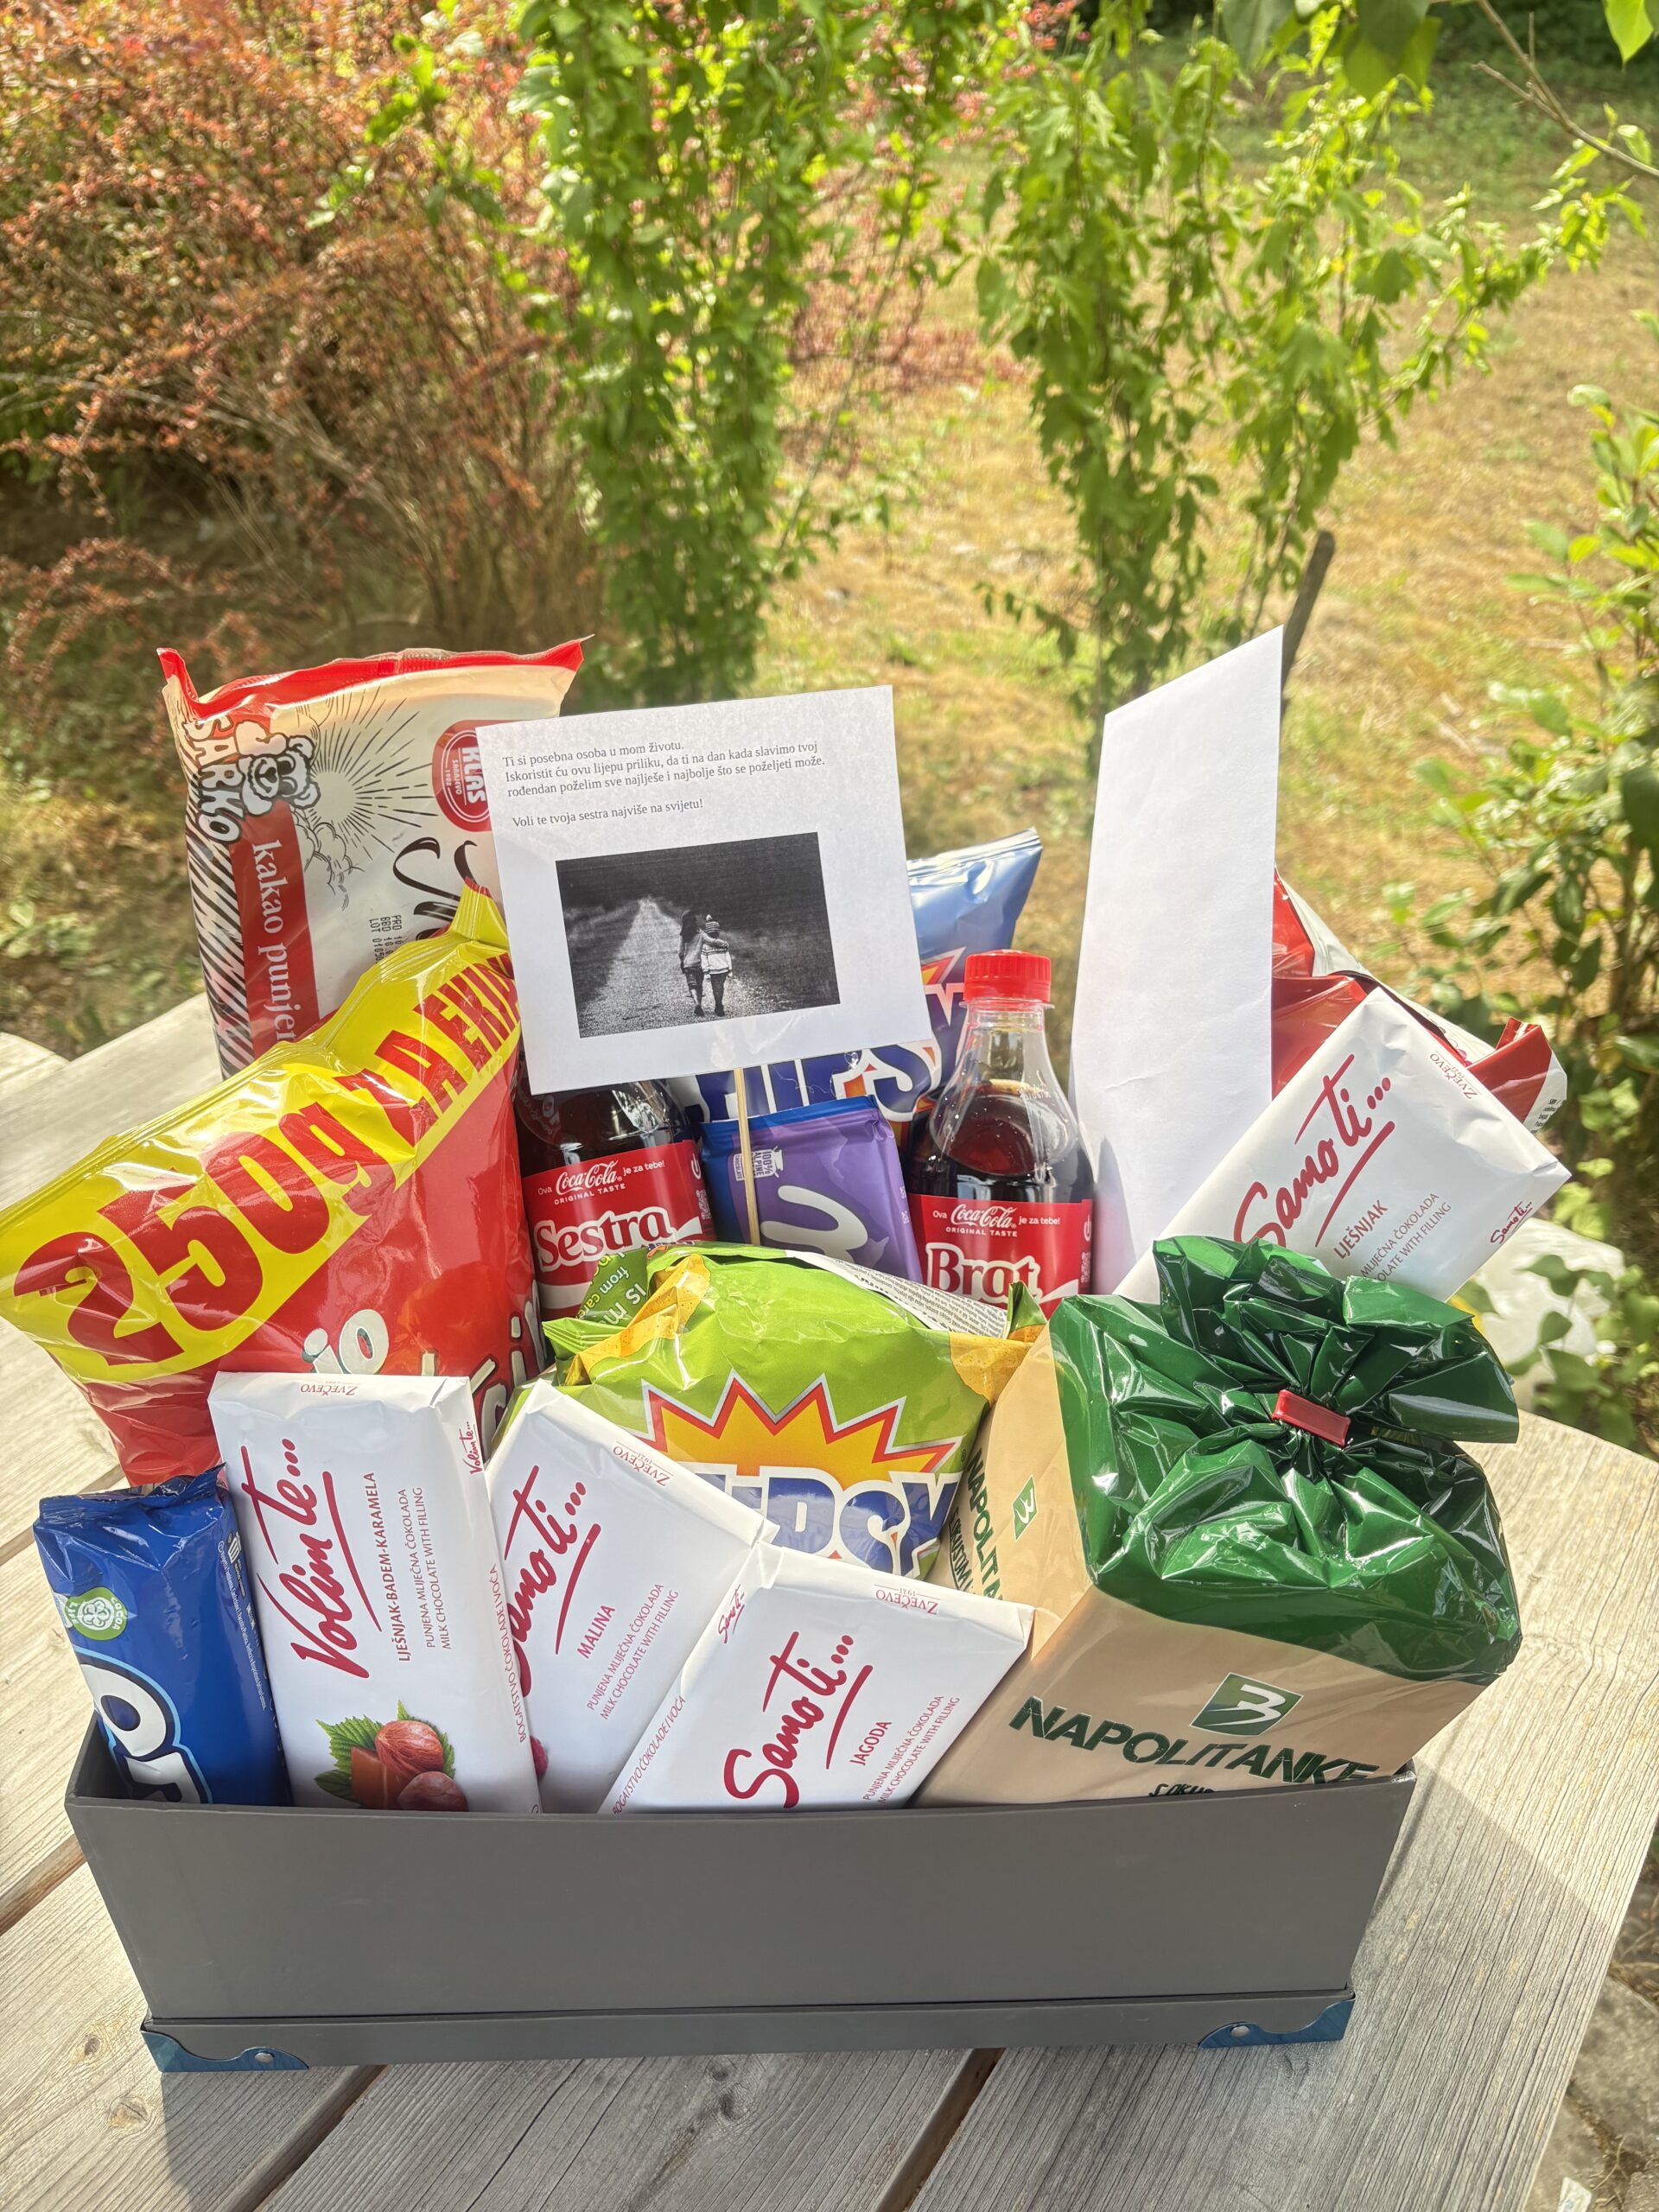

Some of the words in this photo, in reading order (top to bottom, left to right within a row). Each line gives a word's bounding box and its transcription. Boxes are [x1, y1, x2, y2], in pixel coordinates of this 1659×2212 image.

[462, 747, 486, 804] KLAS
[502, 756, 514, 766] Ti
[518, 755, 526, 765] si
[530, 752, 573, 766] posebna
[576, 748, 606, 760] osoba
[620, 746, 645, 755] mom
[649, 742, 684, 753] životu.
[505, 770, 552, 781] Iskoristit
[556, 767, 568, 777] ću
[594, 762, 623, 774] lijepu
[626, 758, 664, 772] priliku,
[666, 756, 678, 766] da
[683, 754, 689, 764] ti
[708, 752, 726, 762] dan
[728, 748, 753, 760] kada
[755, 745, 795, 757] slavimo
[798, 741, 817, 753] tvoj
[508, 784, 556, 797] rođendan
[560, 779, 601, 794] poželim
[626, 772, 664, 786] najlješe
[674, 767, 715, 781] najbolje
[718, 766, 732, 776] što
[749, 759, 791, 773] poželjeti
[795, 757, 825, 768] može.
[512, 816, 534, 827] Voli
[537, 816, 546, 824] te
[550, 812, 575, 824] tvoja
[579, 809, 608, 820] sestra
[612, 804, 647, 819] najviše
[651, 804, 662, 813] na
[666, 798, 702, 812] svijetu!
[252, 839, 288, 934] kakao
[369, 918, 380, 933] LOT
[332, 1029, 469, 1148] ZA
[1429, 1053, 1478, 1099] ZVEČEVO
[538, 1186, 553, 1196] Ova
[622, 1167, 632, 1177] je
[644, 1160, 665, 1171] tebe!
[754, 1152, 765, 1177] ALPINE
[762, 1150, 773, 1175] 100%
[554, 1191, 594, 1205] ORIGINAL
[597, 1183, 626, 1195] TASTE
[1233, 1138, 1339, 1248] Samo
[535, 1209, 674, 1270] Sestra
[933, 1210, 947, 1219] Ova
[1019, 1216, 1027, 1225] je
[1040, 1216, 1061, 1225] tebe!
[945, 1226, 986, 1236] ORIGINAL
[1333, 1199, 1389, 1259] LJEŠNJAK
[1360, 1238, 1397, 1278] MLIJEČNA
[1393, 1192, 1440, 1240] ČOKOLADA
[1399, 1232, 1424, 1257] WITH
[1420, 1202, 1452, 1236] FILLING
[600, 1267, 630, 1294] from
[928, 1244, 1040, 1302] Brat
[300, 1382, 358, 1397] ZVEČEVO
[461, 1440, 484, 1475] Volim
[613, 1446, 671, 1486] ZVEČEVO
[397, 1489, 416, 1549] ČOKOLADA
[412, 1487, 429, 1526] FILLING
[419, 1529, 434, 1557] WITH
[363, 1472, 411, 1663] LJEŠNJAK-BADEM-KARAMELA
[409, 1552, 426, 1601] MLIJEČNA
[111, 1597, 124, 1630] COCOA
[257, 1533, 371, 1679] Volim
[426, 1559, 446, 1623] CHOCOLATE
[875, 1589, 939, 1616] ZVEČEVO
[419, 1603, 435, 1648] PUNJENA
[438, 1624, 451, 1649] MILK
[577, 1605, 616, 1660] MALINA
[587, 1674, 613, 1711] PUNJENA
[607, 1633, 636, 1675] MLIJEČNA
[629, 1583, 664, 1633] ČOKOLADA
[600, 1697, 618, 1720] MILK
[612, 1646, 646, 1699] CHOCOLATE
[640, 1622, 660, 1647] WITH
[654, 1589, 679, 1624] FILLING
[723, 1696, 824, 1808] Samo
[849, 1721, 893, 1766] JAGODA
[862, 1770, 890, 1801] PUNJENA
[885, 1738, 915, 1770] MLIJEČNA
[907, 1694, 944, 1737] ČOKOLADA
[878, 1787, 896, 1804] MILK
[890, 1745, 926, 1786] CHOCOLATE
[920, 1724, 940, 1744] WITH
[935, 1697, 960, 1724] FILLING
[1009, 1695, 1381, 1785] NAPOLITANKE
[613, 1767, 643, 1815] BOGATSTVO
[639, 1722, 669, 1771] ČOKOLADE
